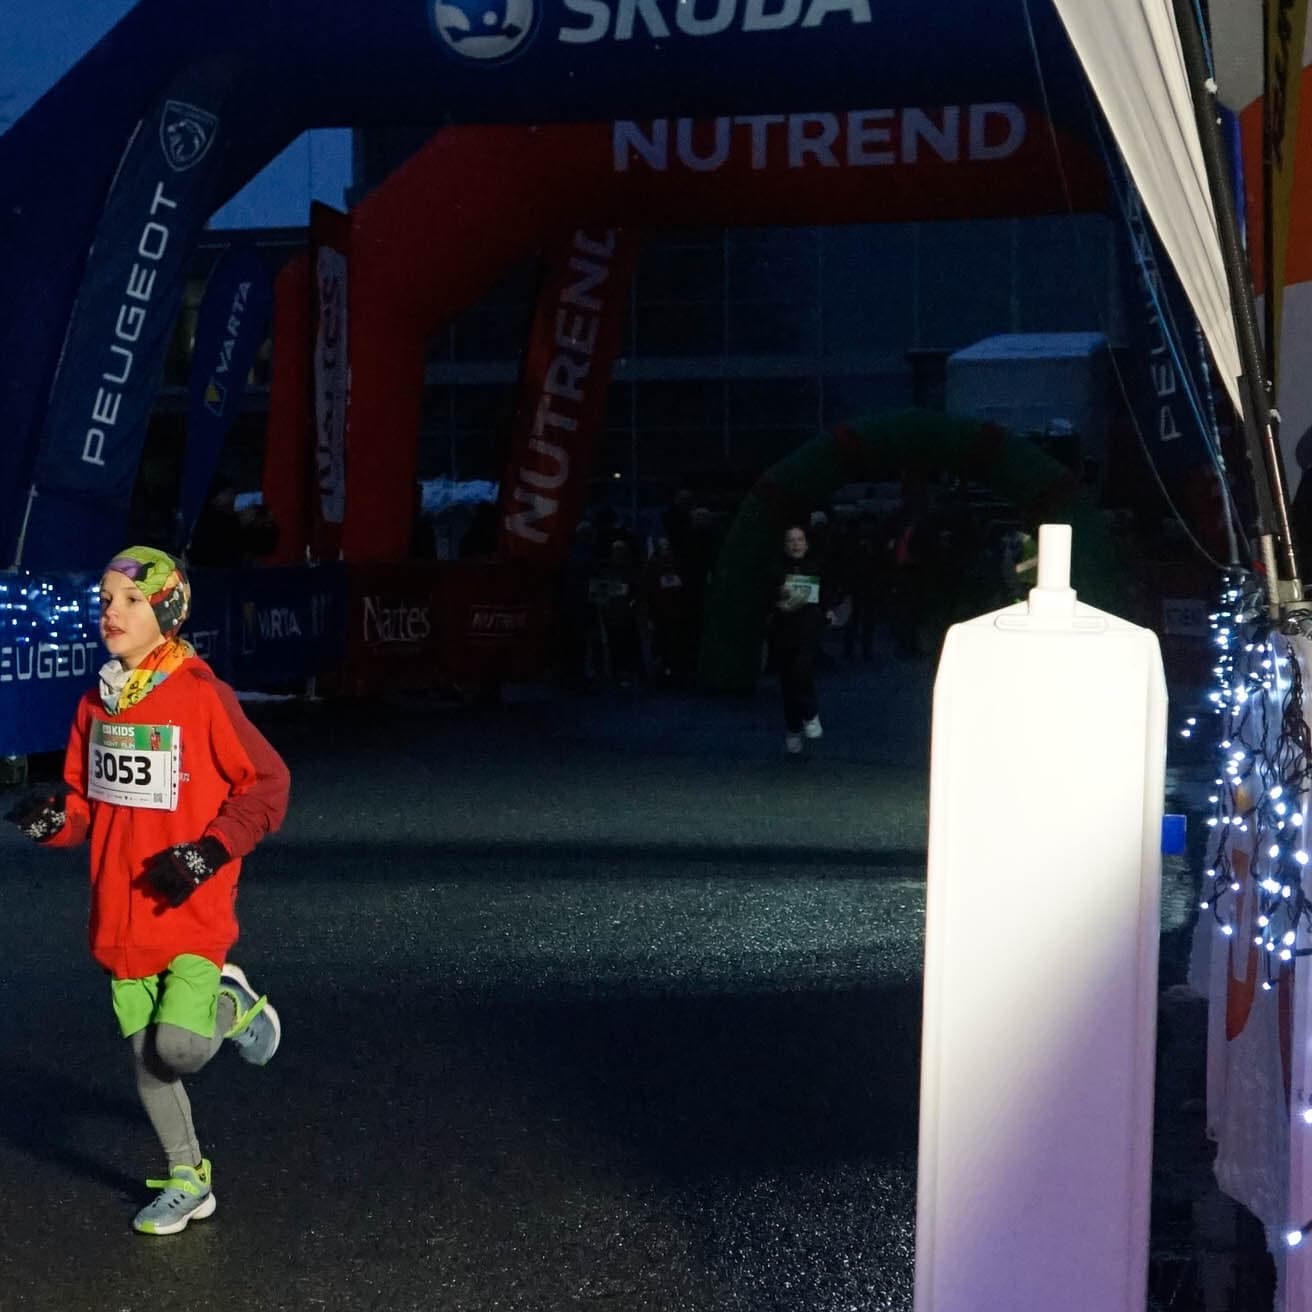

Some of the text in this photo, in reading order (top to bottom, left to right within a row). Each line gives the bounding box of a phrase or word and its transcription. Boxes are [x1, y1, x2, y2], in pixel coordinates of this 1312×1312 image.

[612, 101, 1027, 173] NUTREND
[81, 181, 178, 466] PEUGEOT
[111, 727, 135, 737] KIDS
[94, 750, 152, 786] 3053
